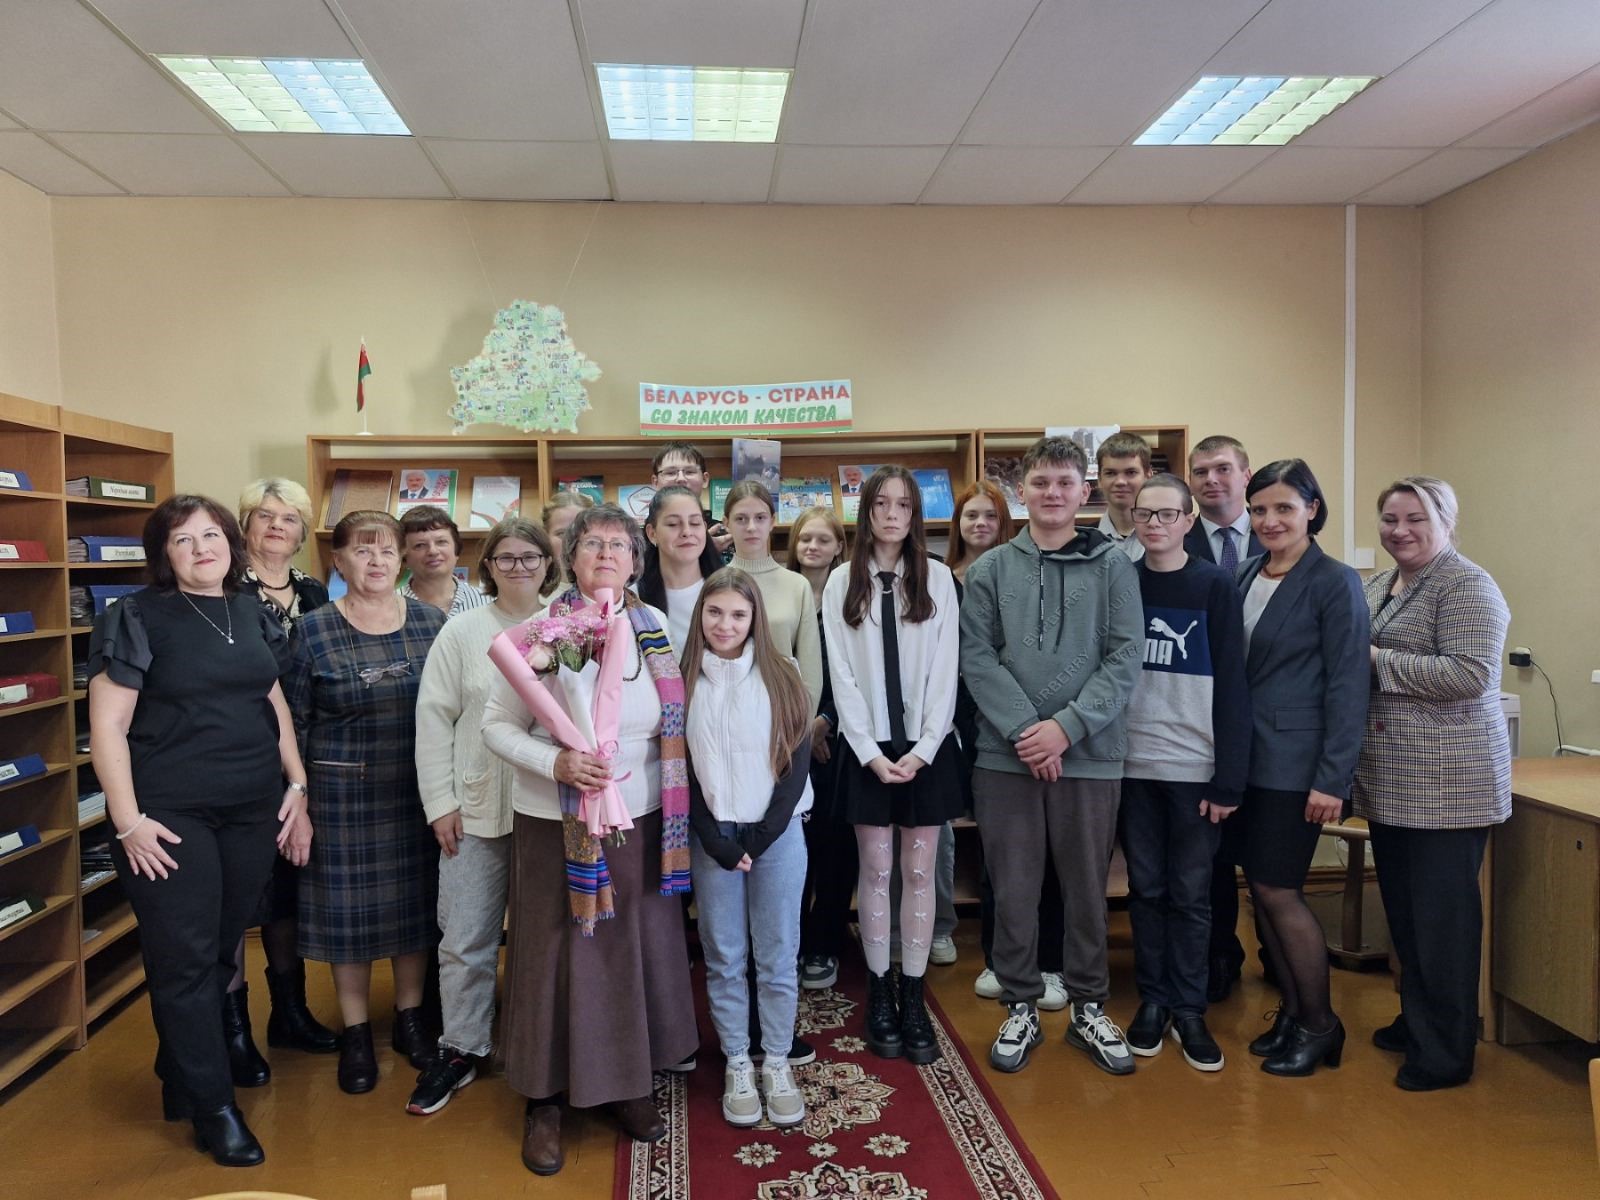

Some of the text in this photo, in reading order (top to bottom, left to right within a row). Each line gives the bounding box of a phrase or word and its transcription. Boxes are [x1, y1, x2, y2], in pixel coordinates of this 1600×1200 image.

[643, 388, 749, 405] БЕЛАРУСЬ
[768, 385, 850, 403] СТРАНА
[651, 404, 837, 425] СО ЗНАКОМ КАЧЕСТВА
[1032, 648, 1089, 708] URBERRY
